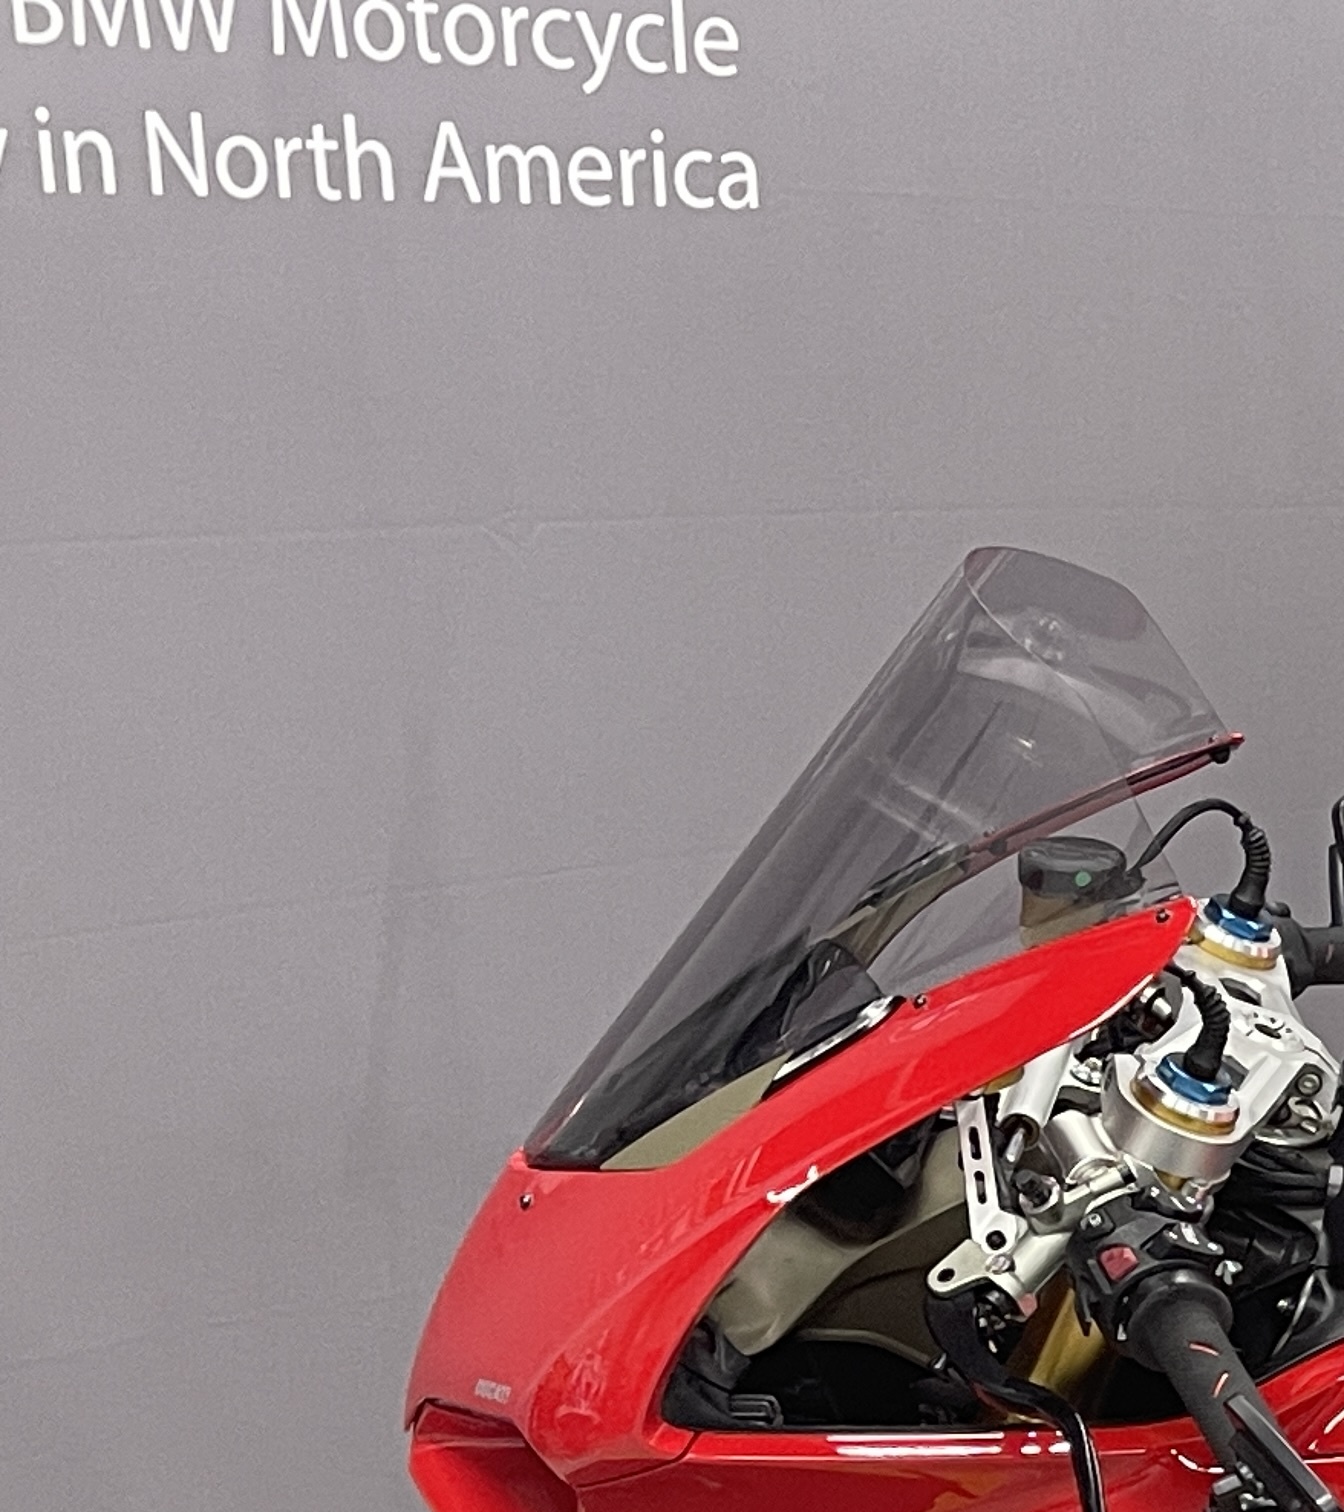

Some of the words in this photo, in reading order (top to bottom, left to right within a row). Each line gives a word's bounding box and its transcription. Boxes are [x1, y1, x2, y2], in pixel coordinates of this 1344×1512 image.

[272, 0, 740, 95] Motorcycle
[34, 106, 117, 195] in
[145, 110, 395, 202] North
[423, 121, 761, 210] America
